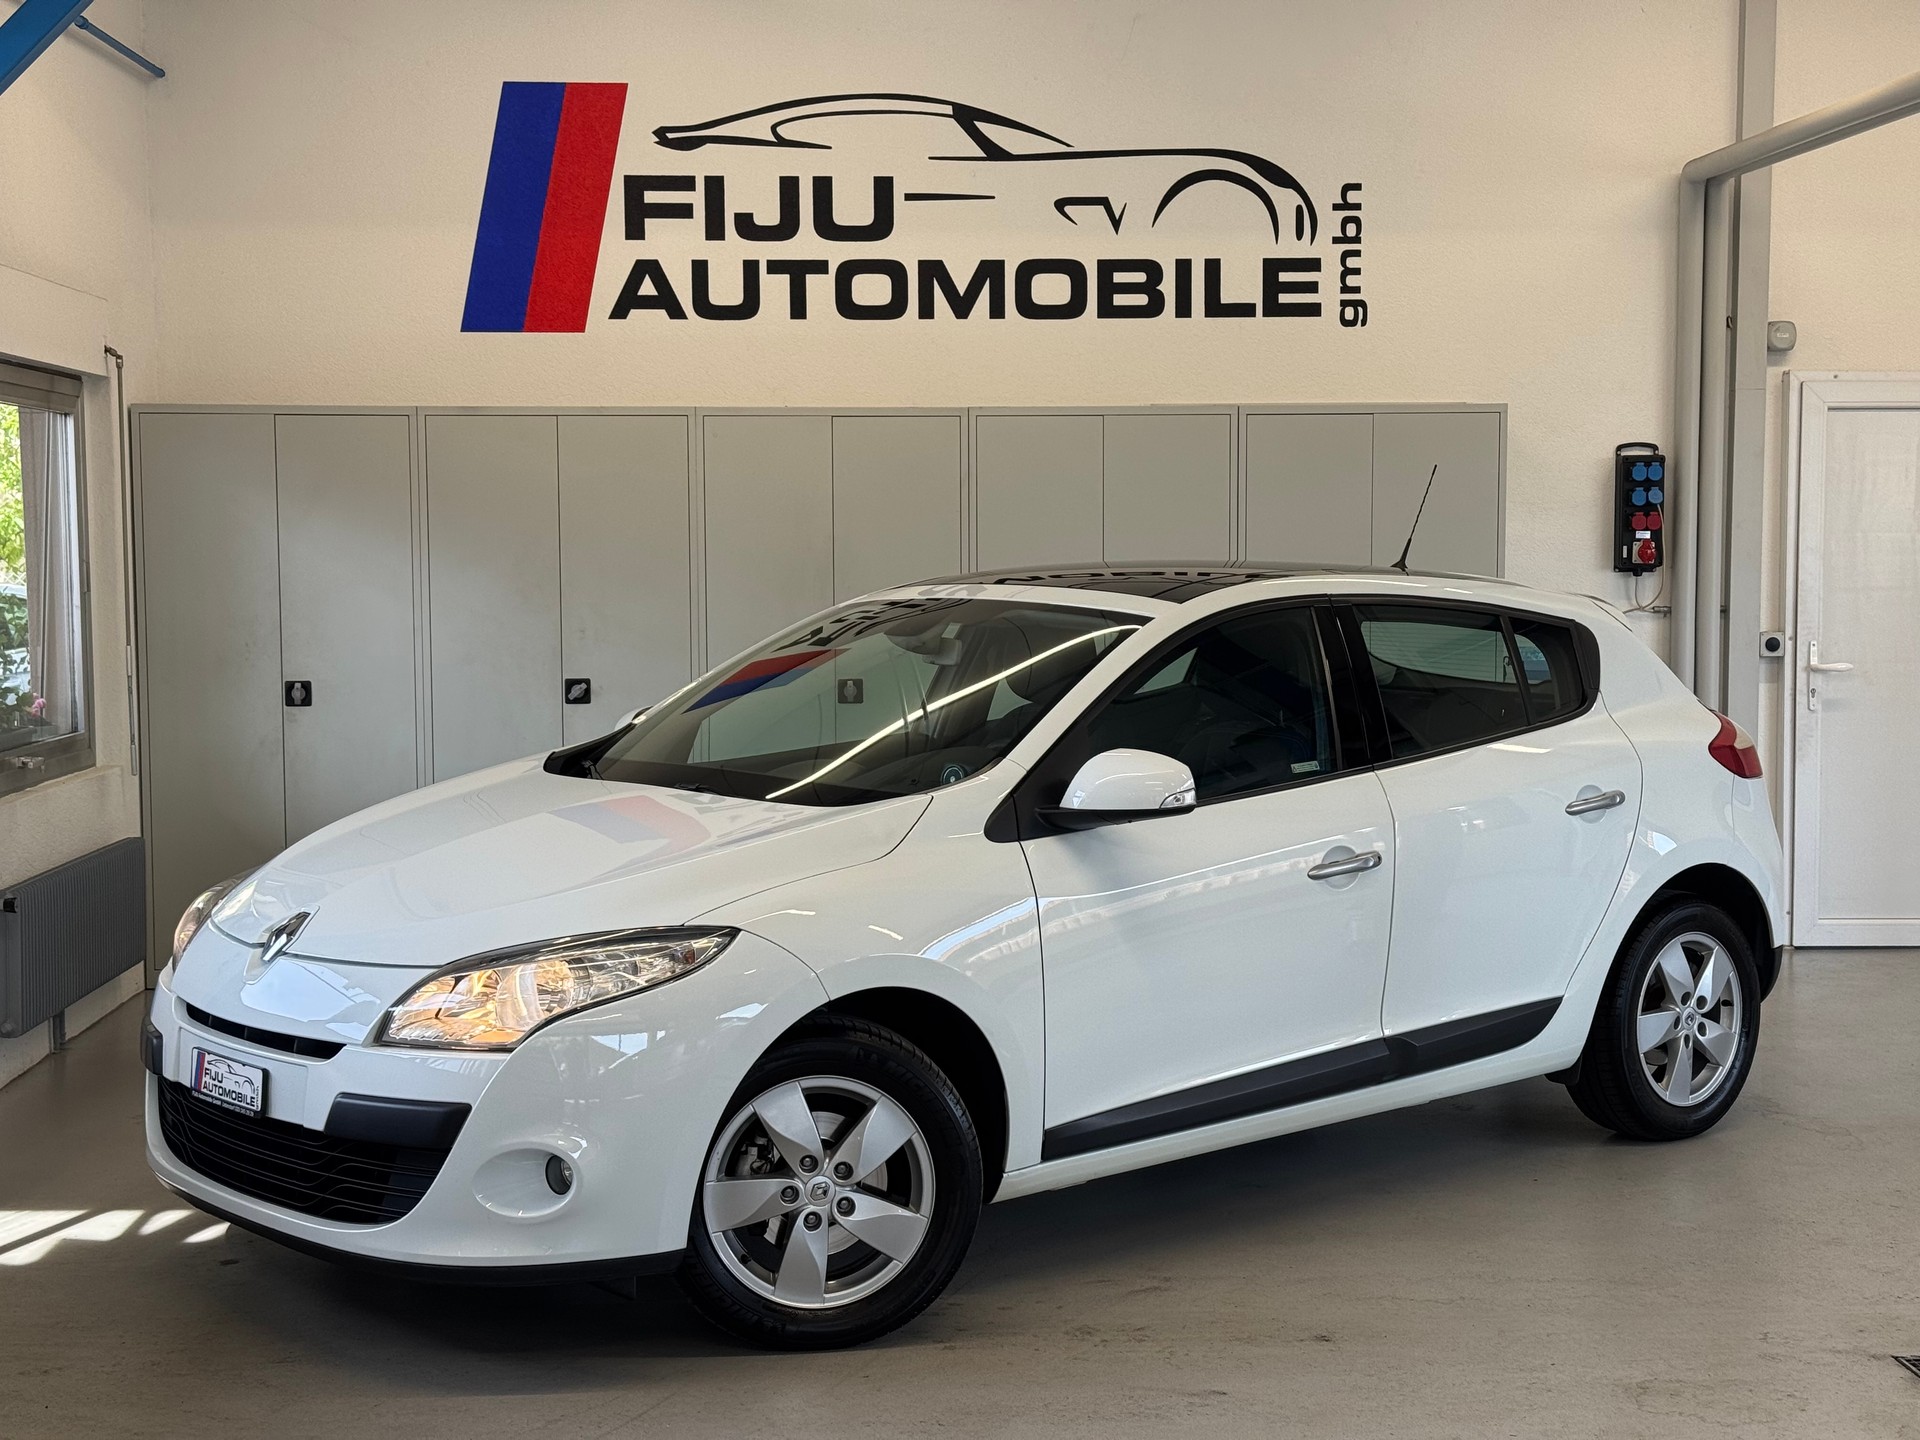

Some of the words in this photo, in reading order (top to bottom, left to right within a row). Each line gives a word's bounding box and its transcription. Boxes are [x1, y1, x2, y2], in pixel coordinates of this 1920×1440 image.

[623, 174, 895, 243] FIJU
[1331, 181, 1368, 328] gmbh
[607, 257, 1322, 321] AUTOMOBILE
[202, 1080, 255, 1107] AUTOMOBILE
[204, 1067, 223, 1083] FIJU
